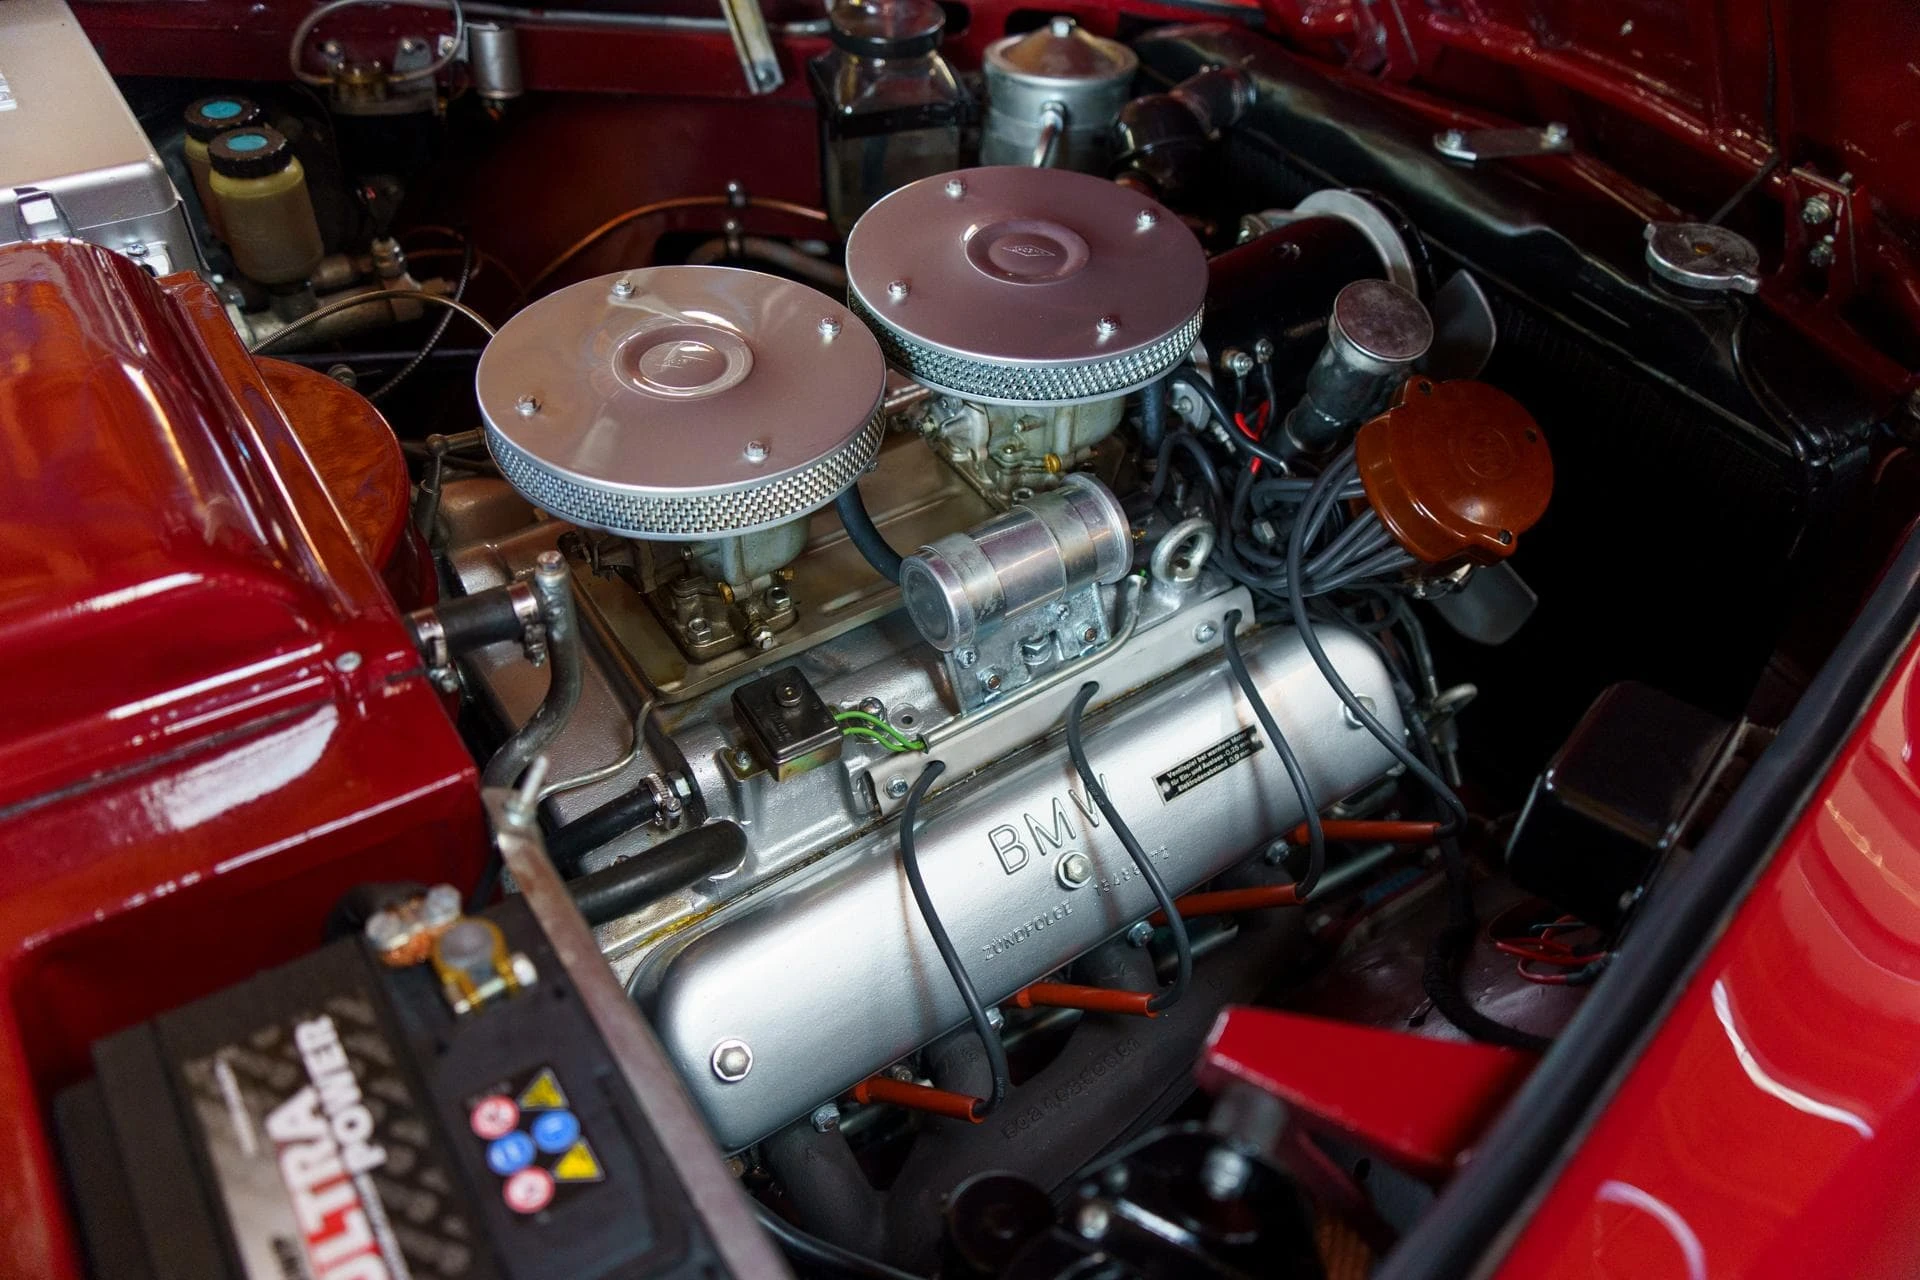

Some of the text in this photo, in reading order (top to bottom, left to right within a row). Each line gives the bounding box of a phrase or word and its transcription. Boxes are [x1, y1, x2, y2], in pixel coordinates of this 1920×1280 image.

[988, 773, 1112, 876] BMW
[982, 900, 1074, 961] ZÜNDFOLGE
[295, 1013, 387, 1174] POWER
